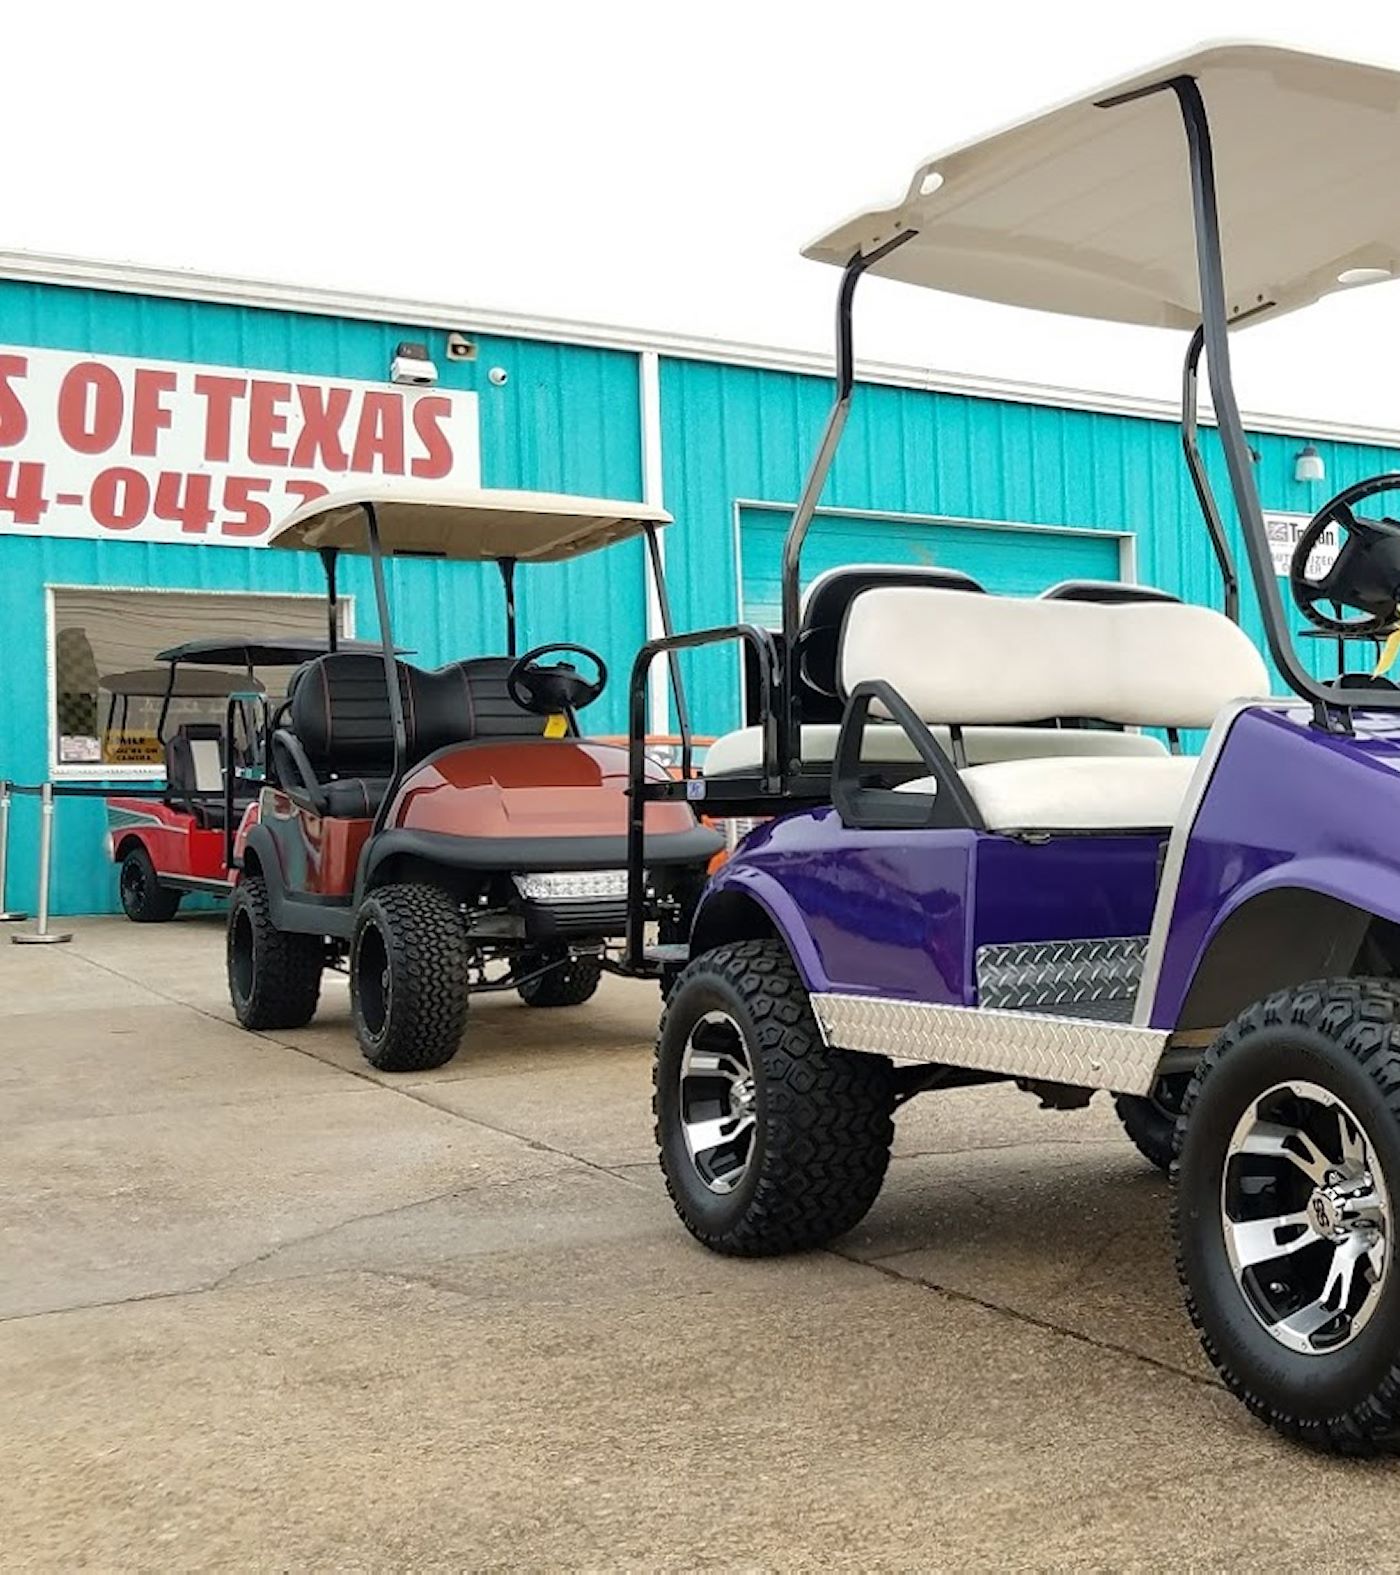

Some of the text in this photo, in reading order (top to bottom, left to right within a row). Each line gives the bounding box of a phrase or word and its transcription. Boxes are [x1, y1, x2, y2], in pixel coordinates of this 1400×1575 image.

[57, 361, 178, 457] OF
[194, 374, 454, 479] TEXAS
[1289, 523, 1334, 546] Tran
